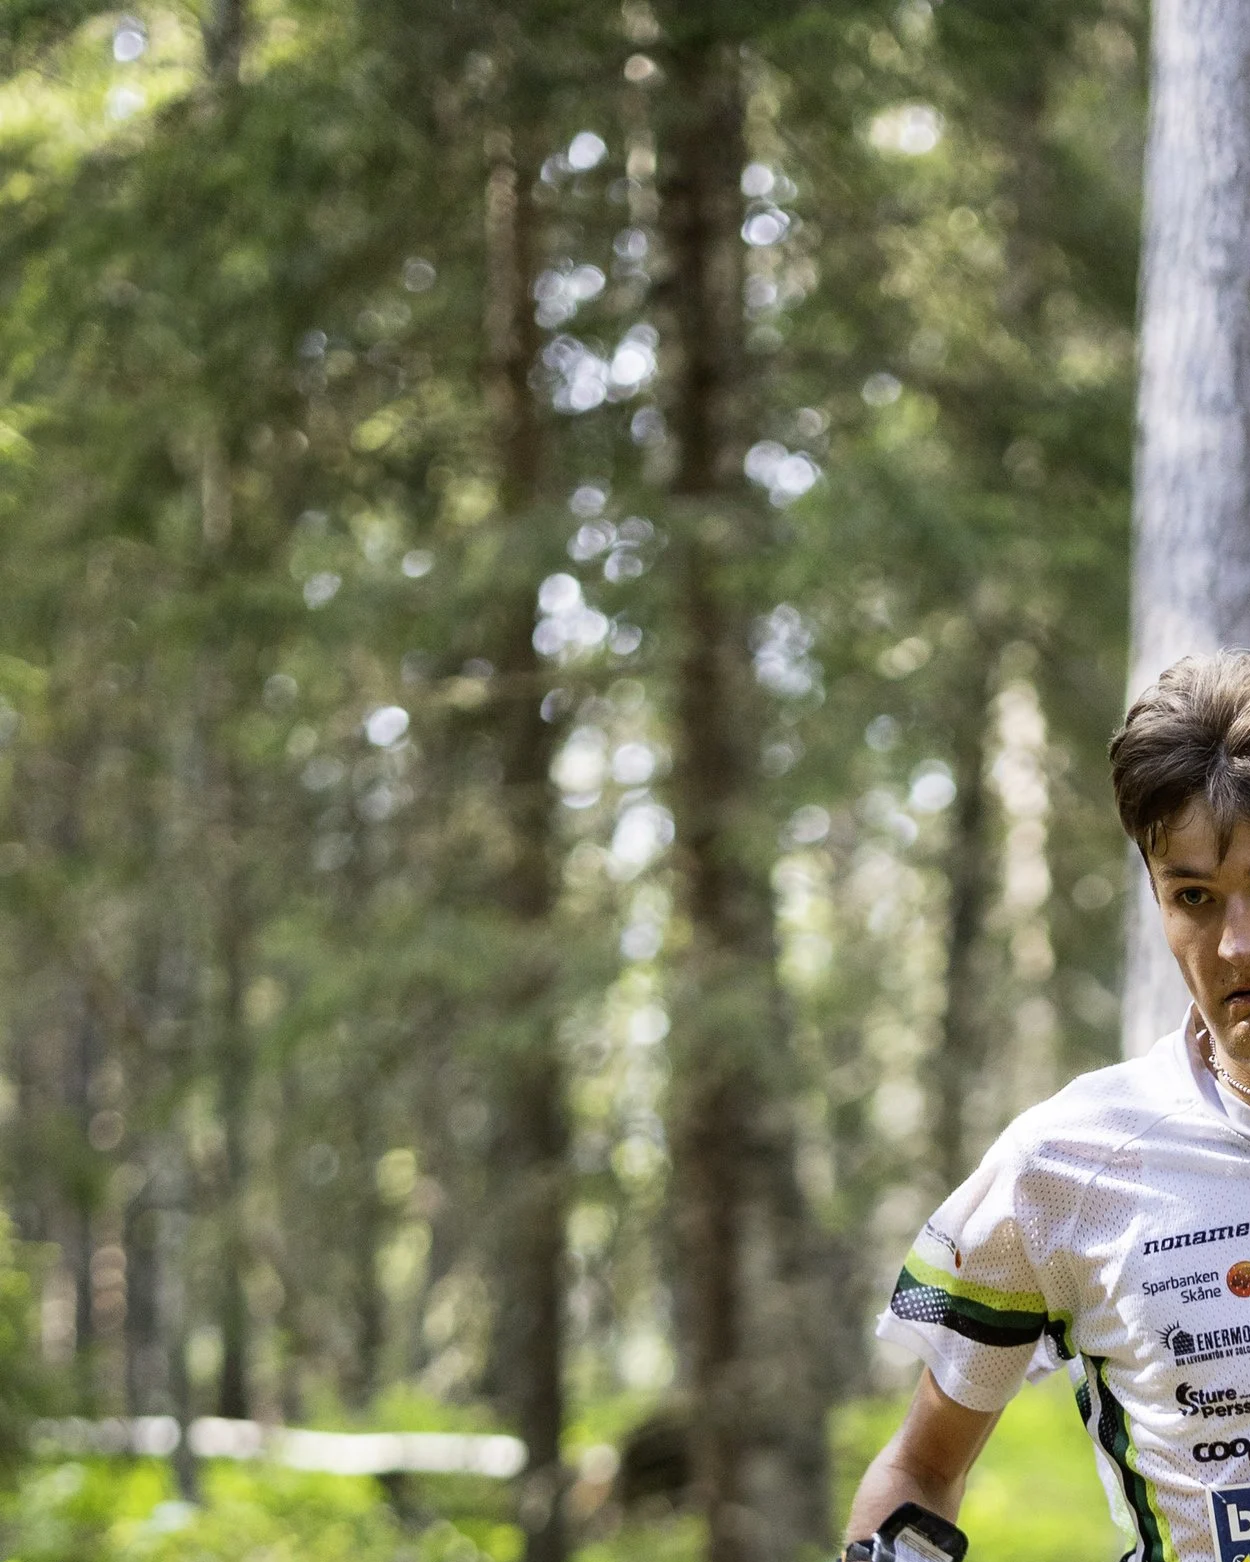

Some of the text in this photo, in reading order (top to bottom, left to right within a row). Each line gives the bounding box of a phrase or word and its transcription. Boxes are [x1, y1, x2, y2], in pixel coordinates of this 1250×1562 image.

[1143, 1222, 1250, 1255] noname
[1142, 1271, 1219, 1296] Sparbanken
[1180, 1286, 1222, 1304] Skåne
